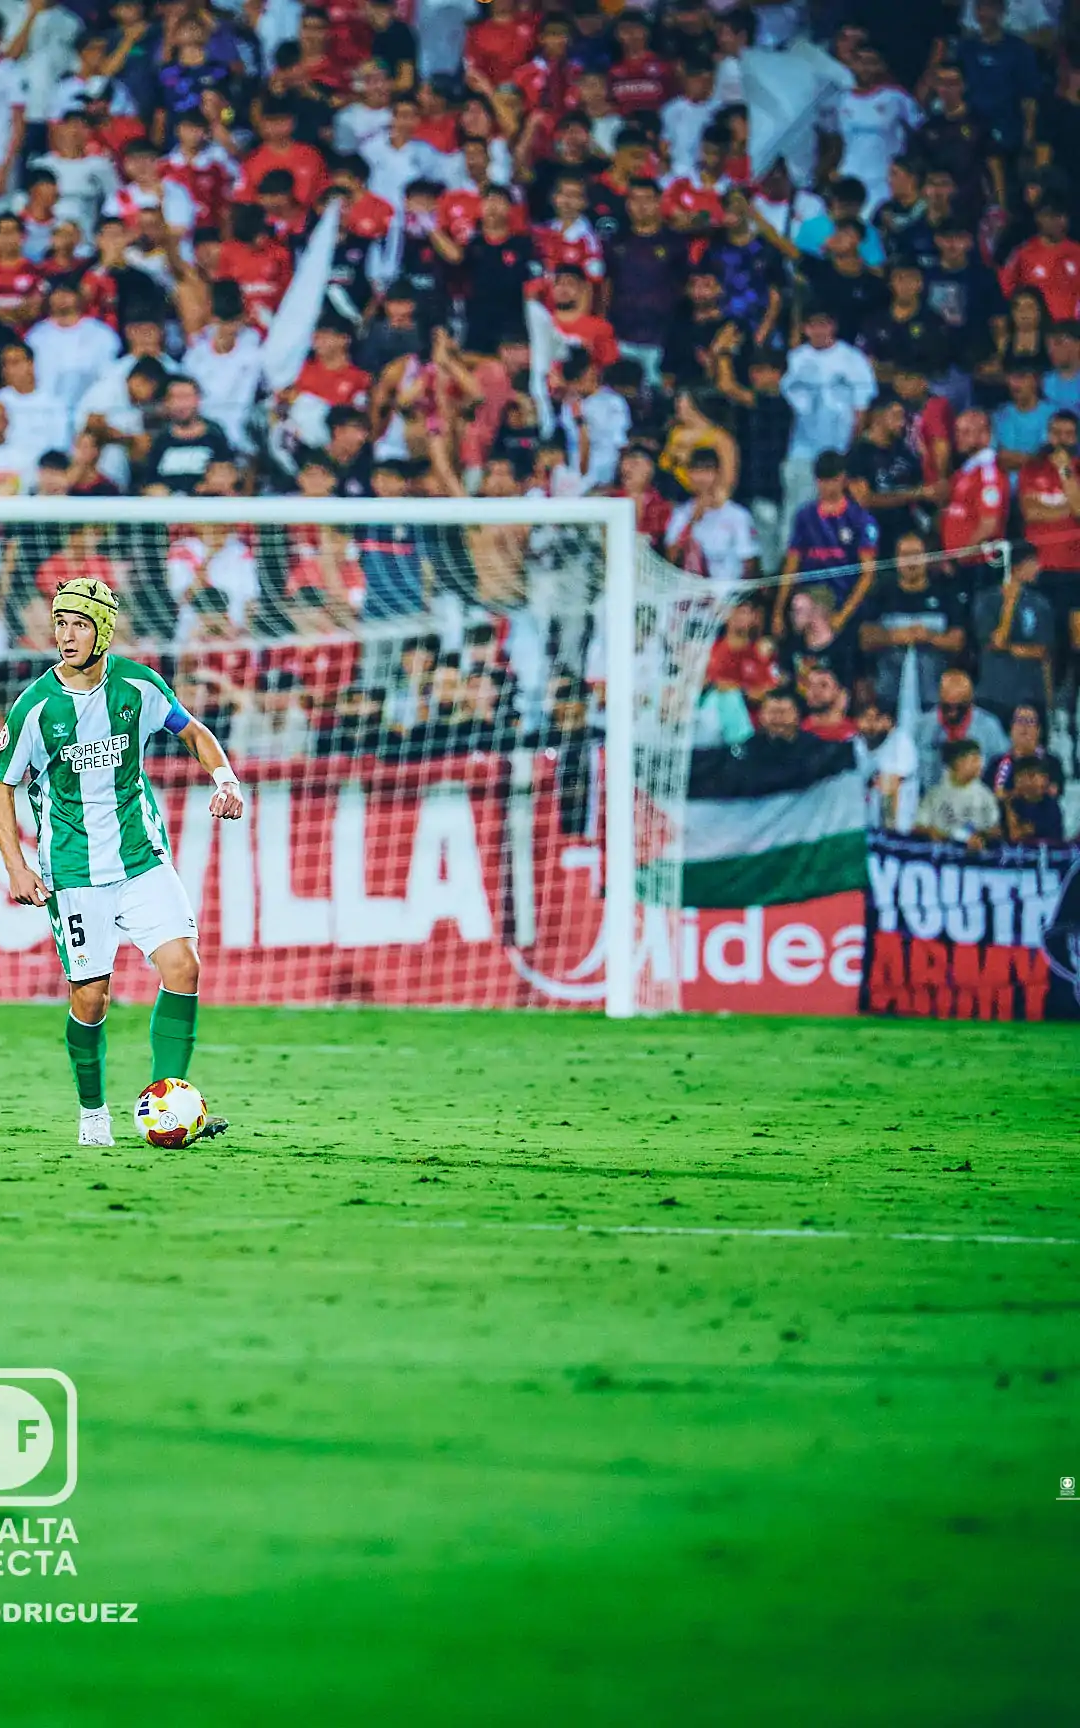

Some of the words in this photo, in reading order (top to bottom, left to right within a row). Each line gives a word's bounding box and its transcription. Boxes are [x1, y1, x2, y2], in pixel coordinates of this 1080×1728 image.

[74, 752, 120, 771] GREEN
[68, 913, 86, 948] 5
[866, 851, 1061, 948] YOUTH
[870, 931, 1050, 1021] ARMY
